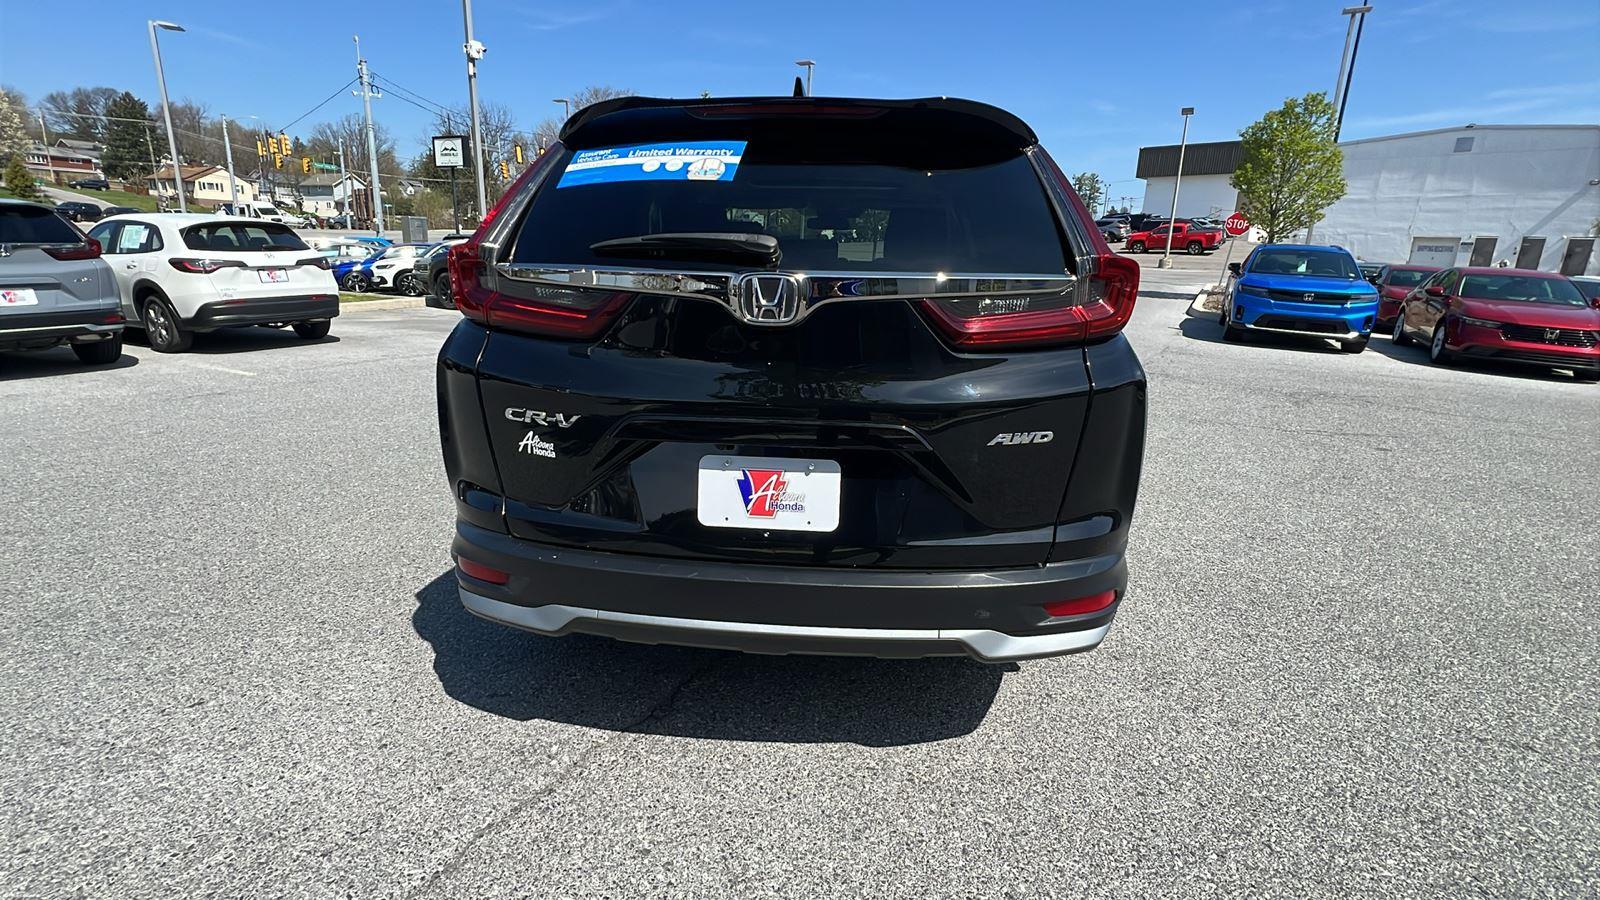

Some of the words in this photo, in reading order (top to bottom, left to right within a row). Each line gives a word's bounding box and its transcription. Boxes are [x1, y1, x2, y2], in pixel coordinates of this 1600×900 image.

[579, 149, 613, 158] Assurant
[602, 153, 620, 161] Care
[628, 148, 673, 158] Limited
[675, 148, 734, 157] Warranty
[1226, 219, 1250, 230] STOP
[504, 407, 581, 428] CR-V
[986, 430, 1054, 446] AWD
[532, 446, 556, 459] Honda
[769, 501, 805, 512] Honda
